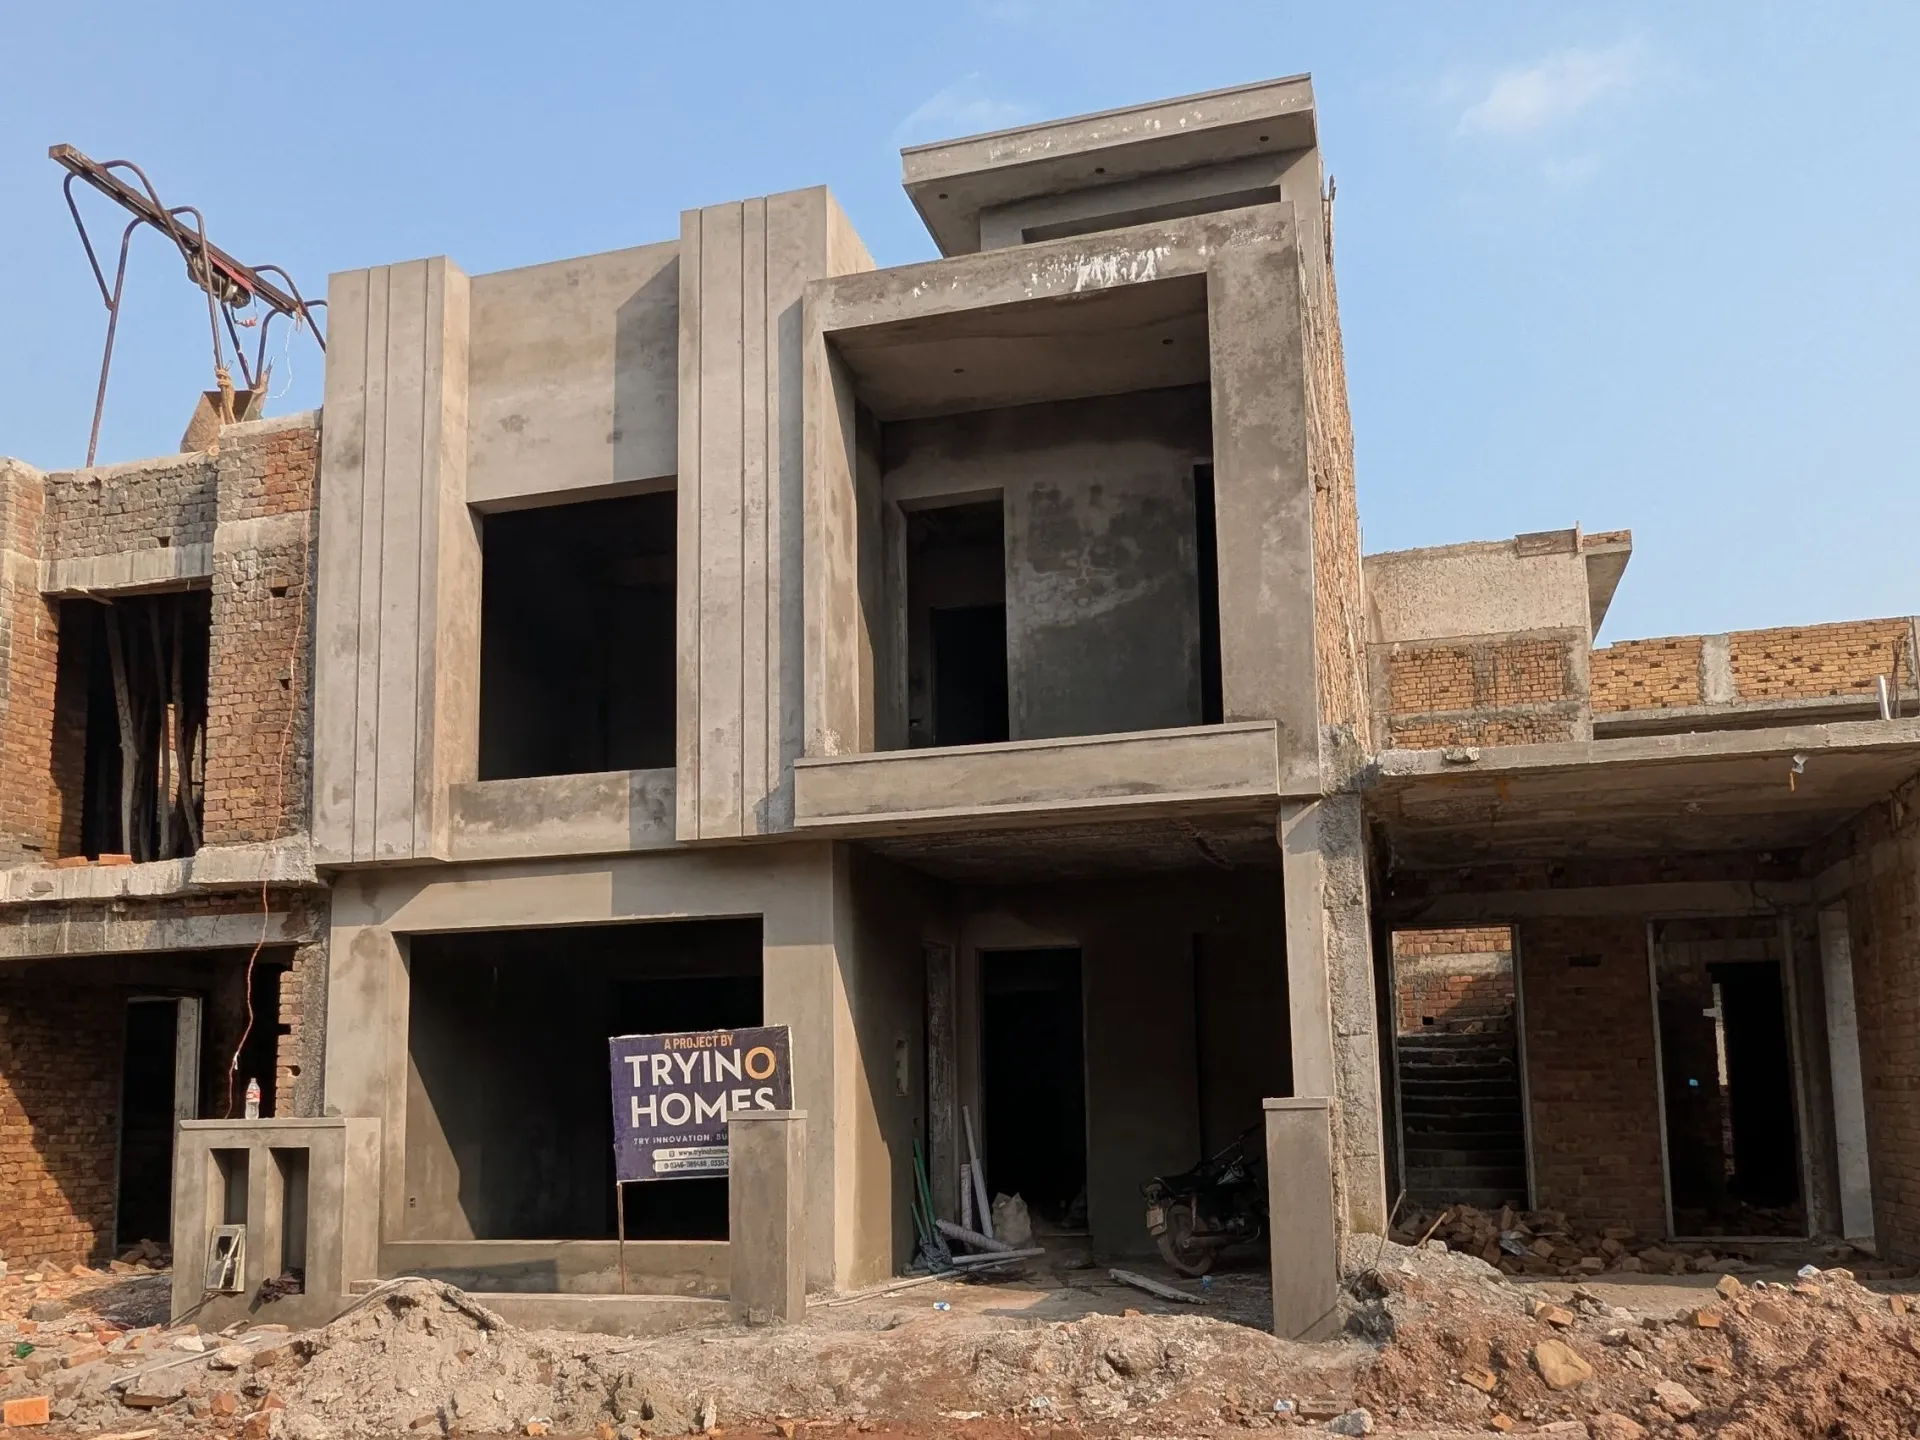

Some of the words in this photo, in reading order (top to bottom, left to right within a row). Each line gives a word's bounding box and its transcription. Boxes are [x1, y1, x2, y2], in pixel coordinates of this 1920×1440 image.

[664, 1038, 672, 1050] A
[673, 1036, 717, 1049] PROJECT
[721, 1034, 734, 1047] BY
[624, 1046, 776, 1088] TRYINO
[631, 1087, 775, 1128] HOMES
[633, 1136, 650, 1145] TRY
[716, 1133, 728, 1141] BU
